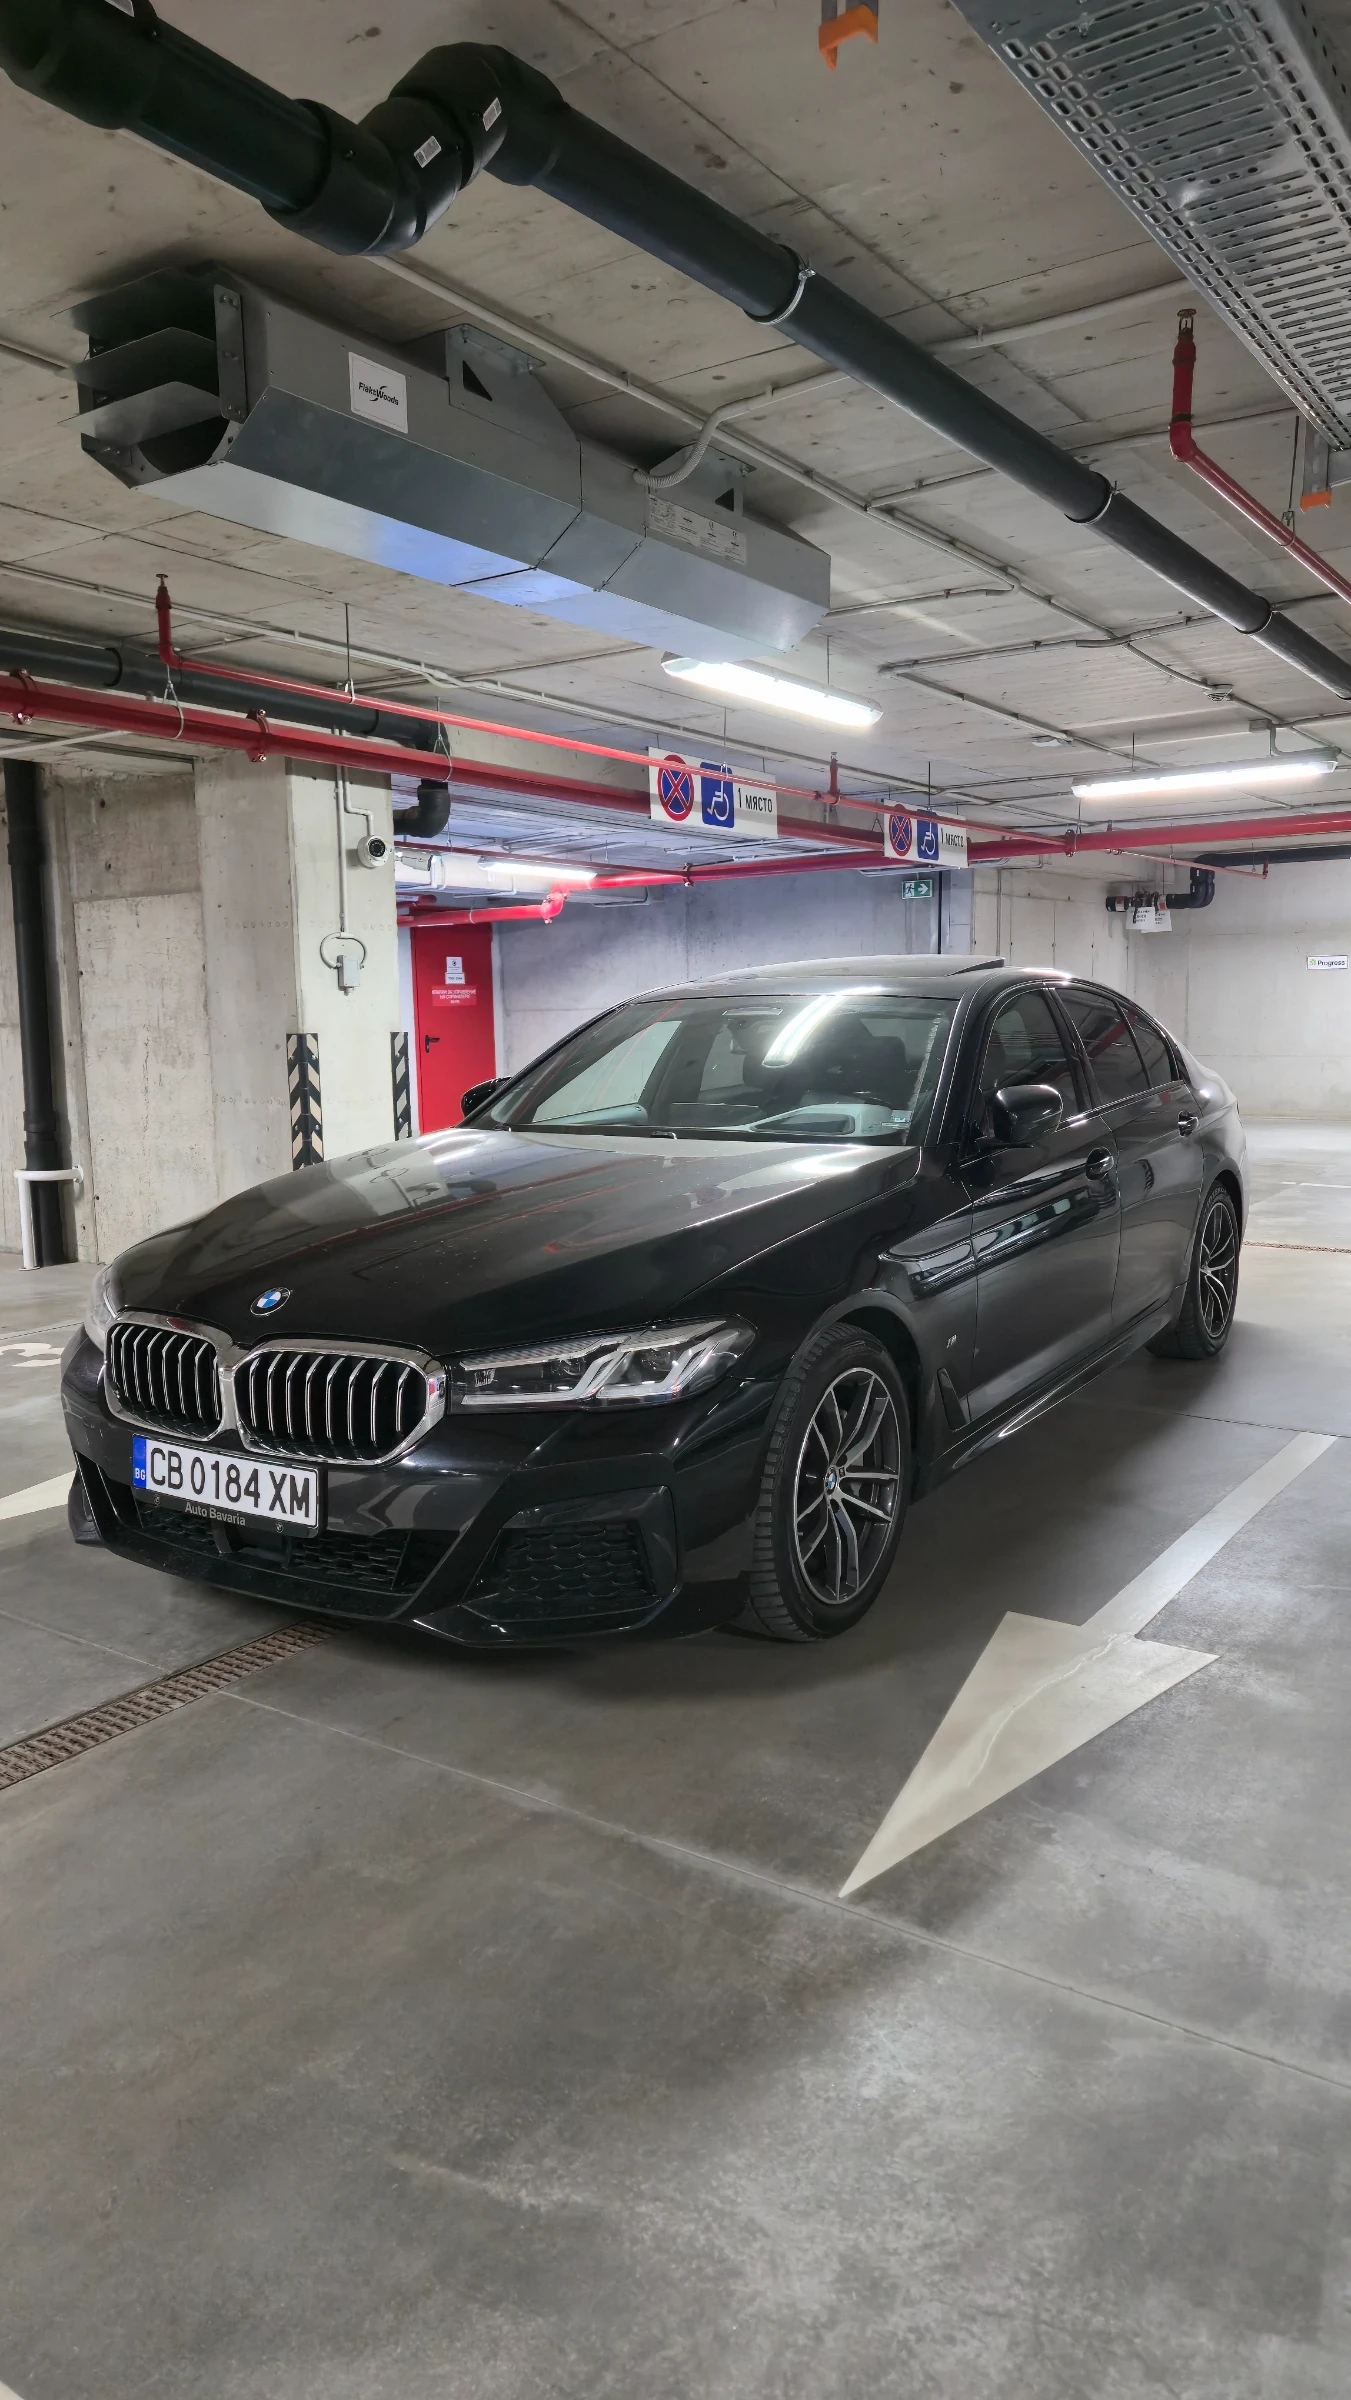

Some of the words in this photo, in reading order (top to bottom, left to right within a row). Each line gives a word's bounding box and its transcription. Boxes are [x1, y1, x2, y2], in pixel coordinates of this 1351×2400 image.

[738, 787, 742, 808] 1
[745, 794, 773, 812] МЯСТО
[135, 1468, 146, 1481] BG
[150, 1447, 184, 1490] CB
[190, 1456, 261, 1509] 0184
[268, 1470, 310, 1518] XM
[184, 1501, 208, 1518] Auto
[209, 1506, 246, 1527] Bavaria
